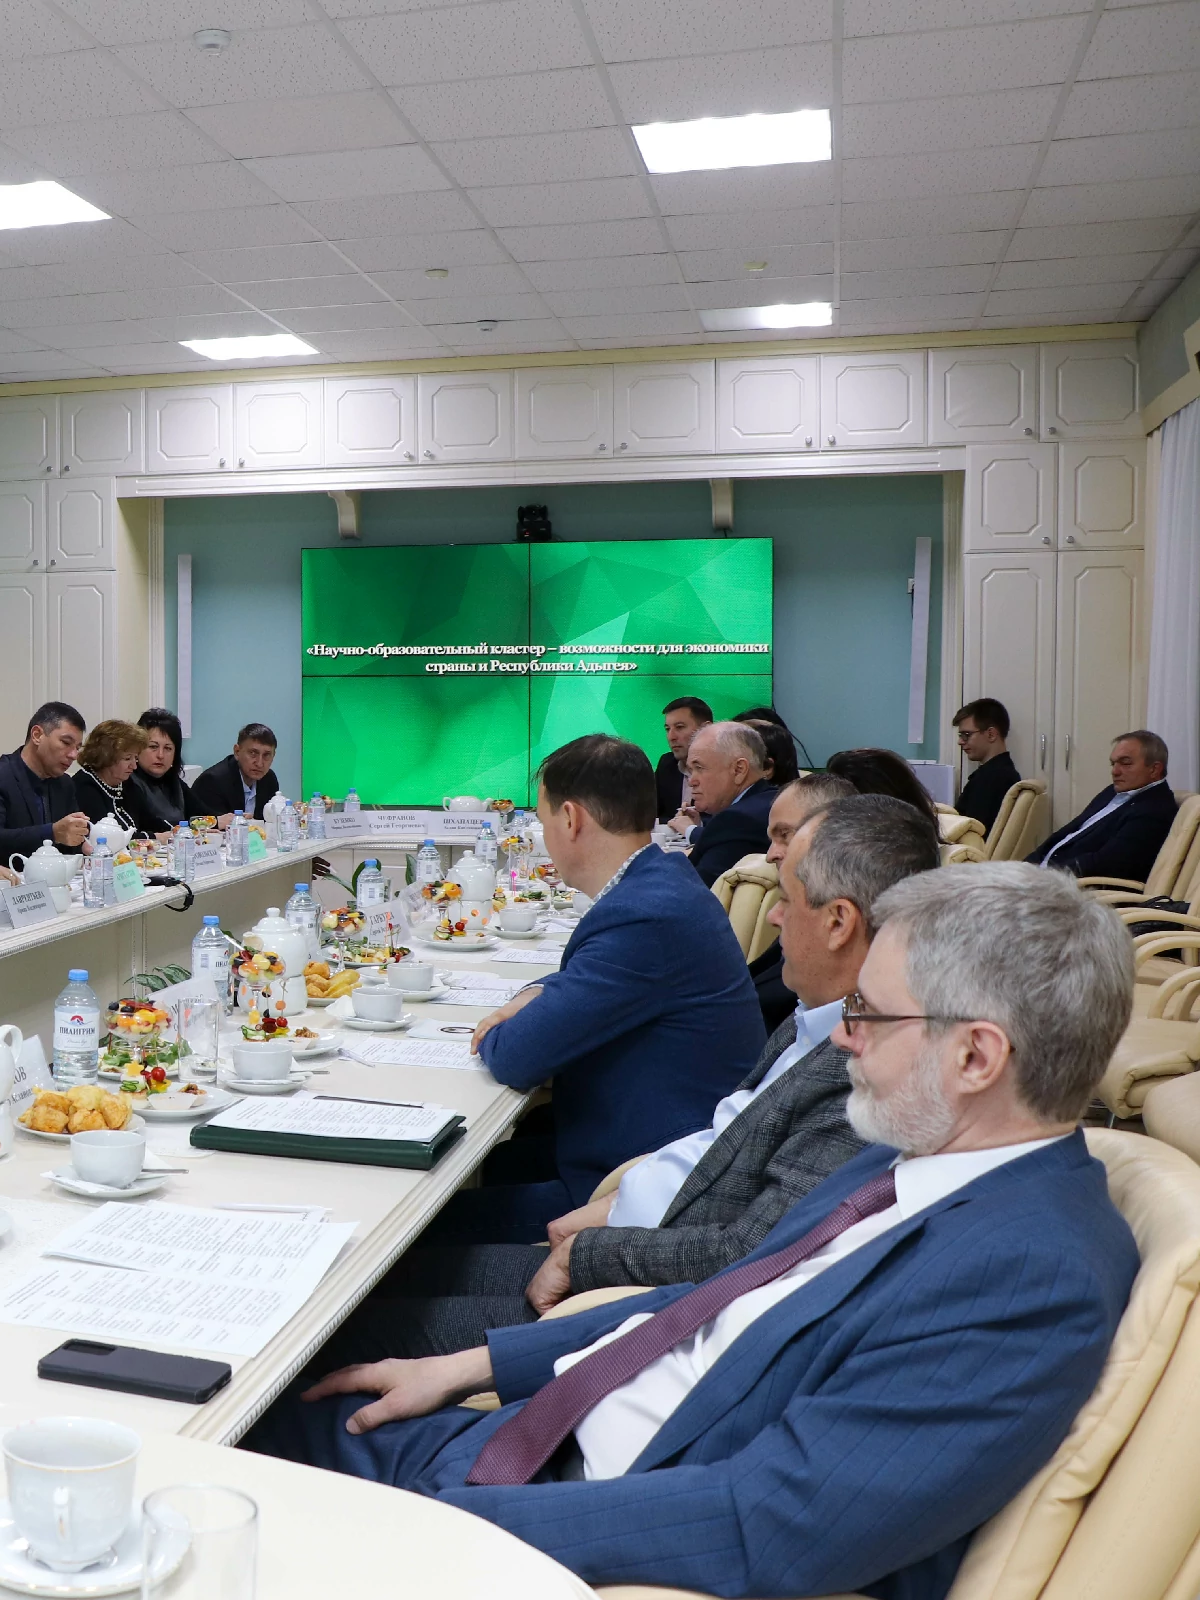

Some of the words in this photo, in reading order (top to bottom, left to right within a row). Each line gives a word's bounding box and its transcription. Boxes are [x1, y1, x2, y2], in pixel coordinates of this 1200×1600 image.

[307, 642, 489, 659] «Научно-образовательный
[490, 644, 545, 655] кластер
[559, 643, 656, 654] возможности
[656, 644, 685, 655] для
[686, 643, 769, 653] экономики
[425, 661, 477, 674] страны
[478, 662, 488, 672] и
[490, 659, 575, 675] Республики
[576, 660, 638, 673] Адыгея»
[369, 911, 395, 925] ГАРКУА
